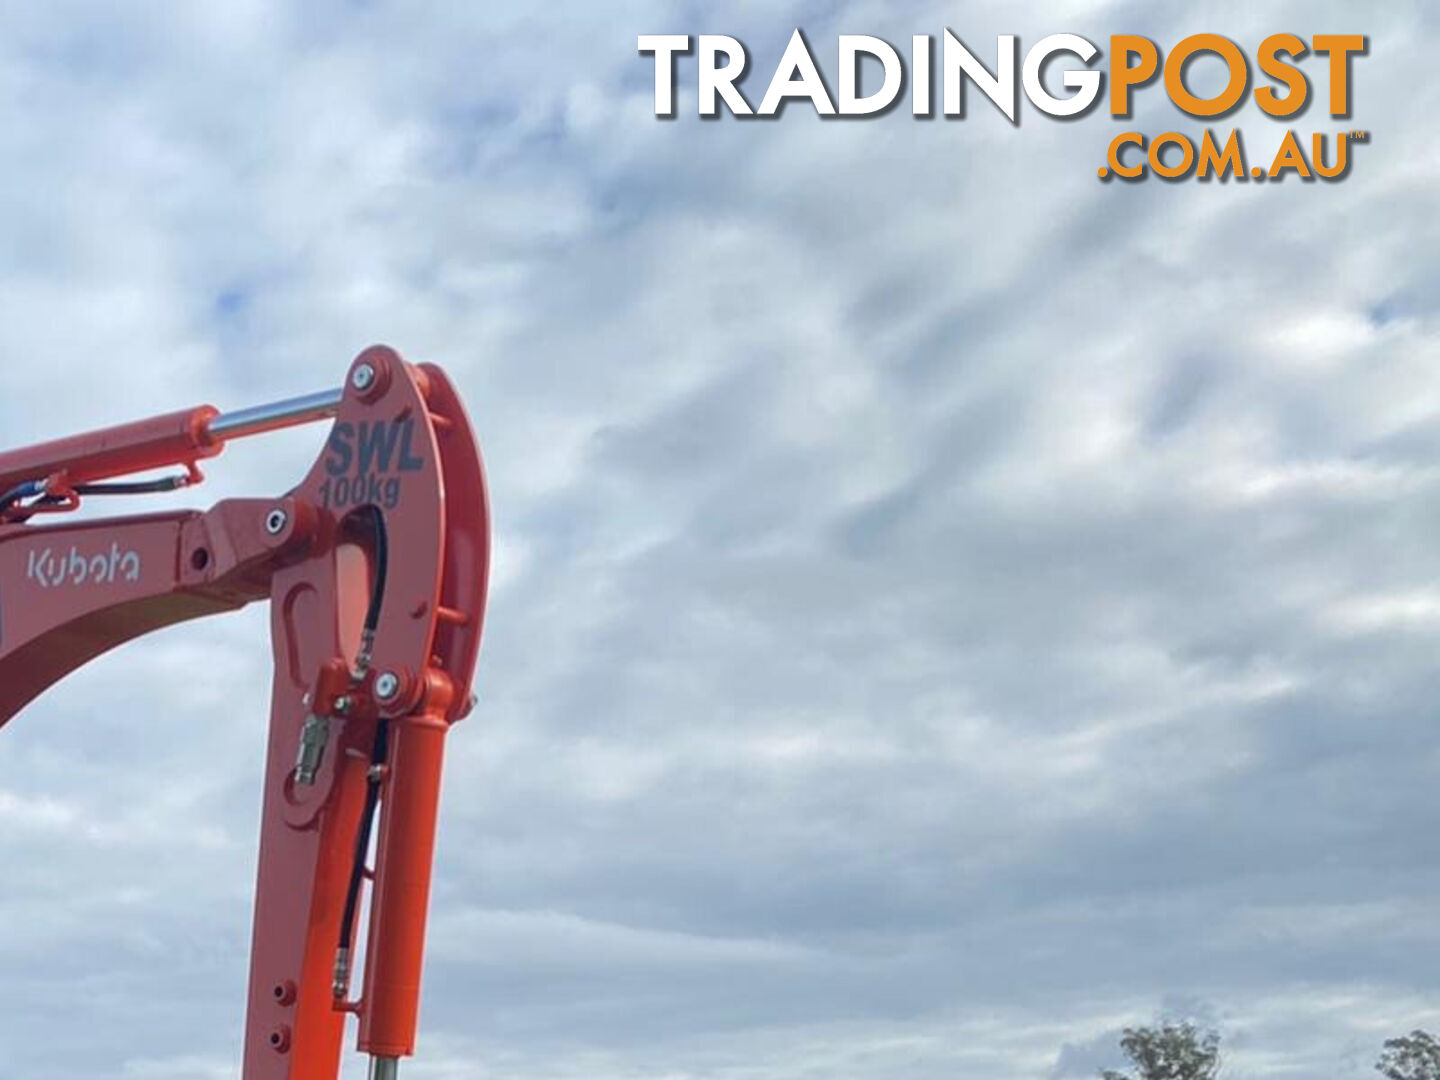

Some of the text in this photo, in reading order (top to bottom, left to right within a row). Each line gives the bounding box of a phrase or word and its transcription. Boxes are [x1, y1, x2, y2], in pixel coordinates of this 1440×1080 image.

[325, 418, 425, 476] SWL
[319, 473, 401, 509] 100kg
[28, 541, 141, 587] Kubota
